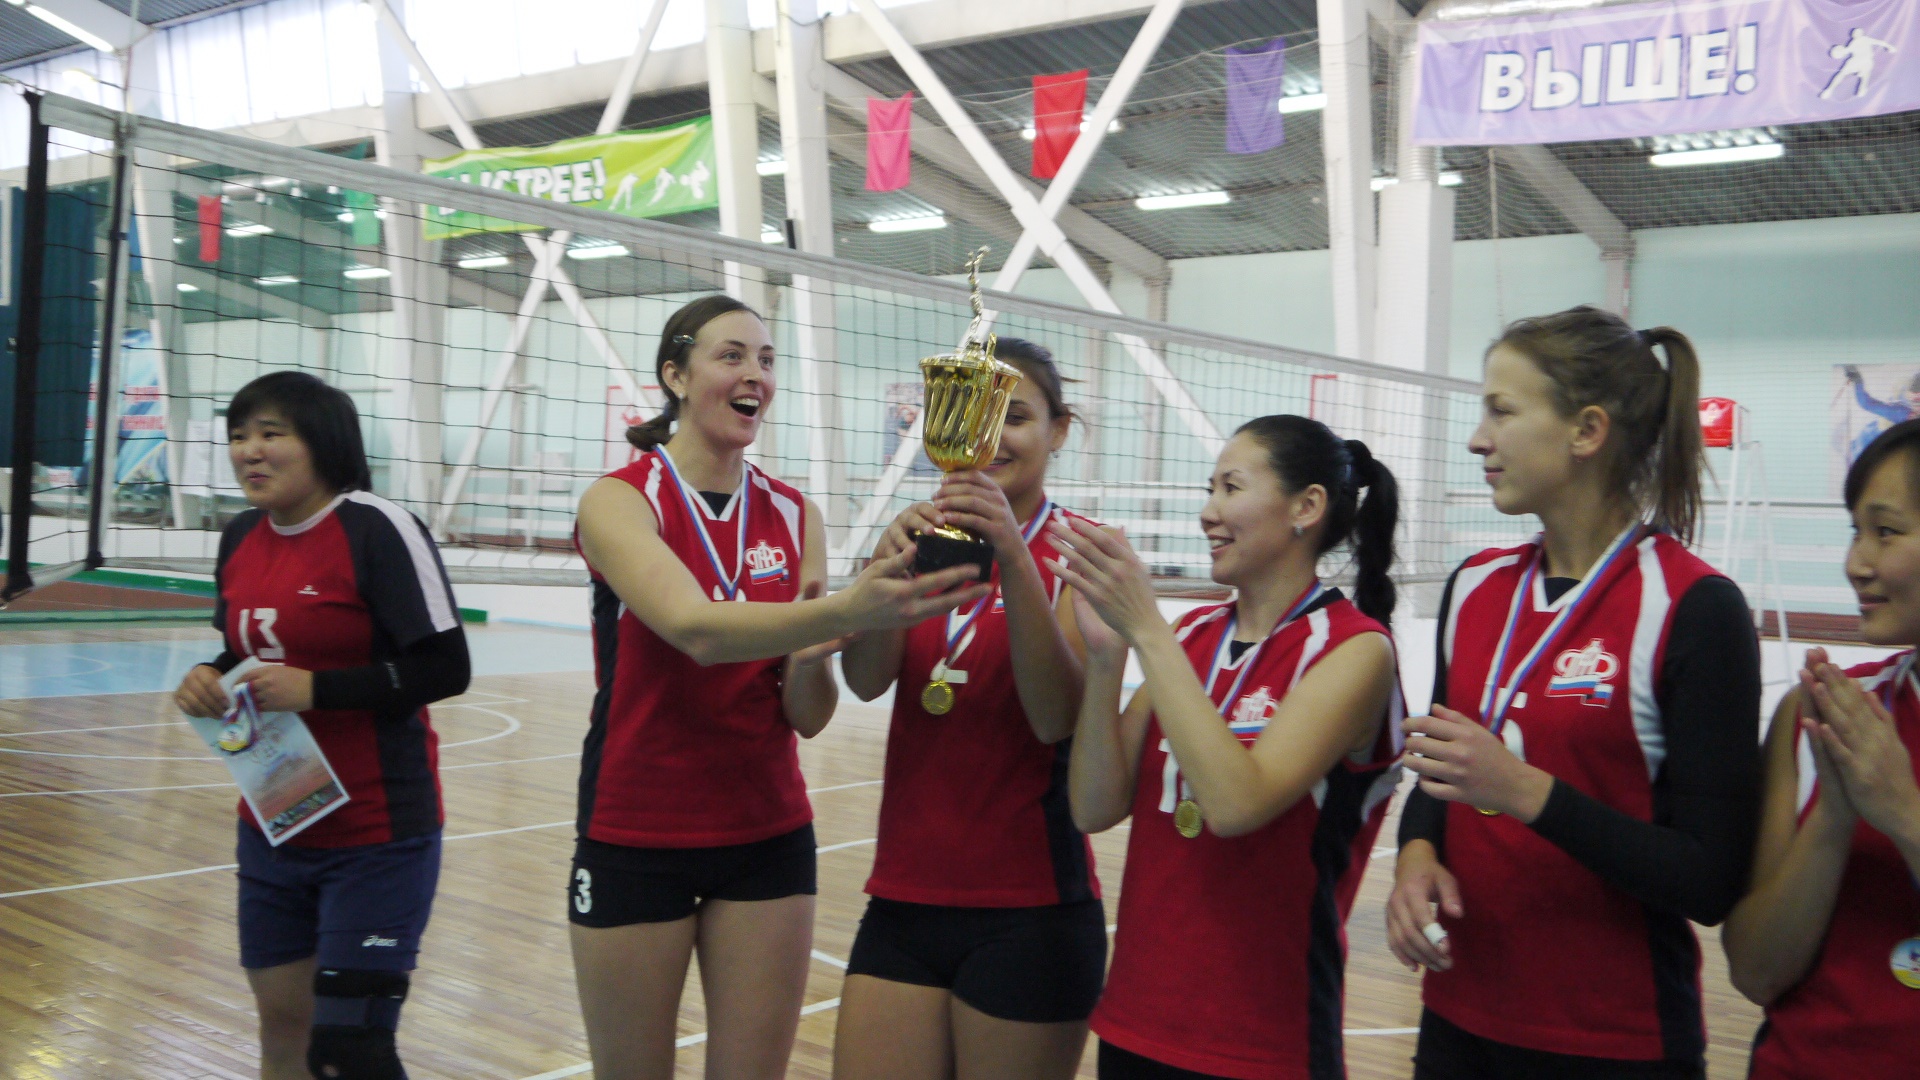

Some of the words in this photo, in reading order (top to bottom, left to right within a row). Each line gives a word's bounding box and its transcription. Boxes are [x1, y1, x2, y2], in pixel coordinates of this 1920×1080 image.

[1480, 21, 1758, 112] ВЫШЕ!
[239, 607, 286, 659] 13
[574, 868, 592, 914] 3
